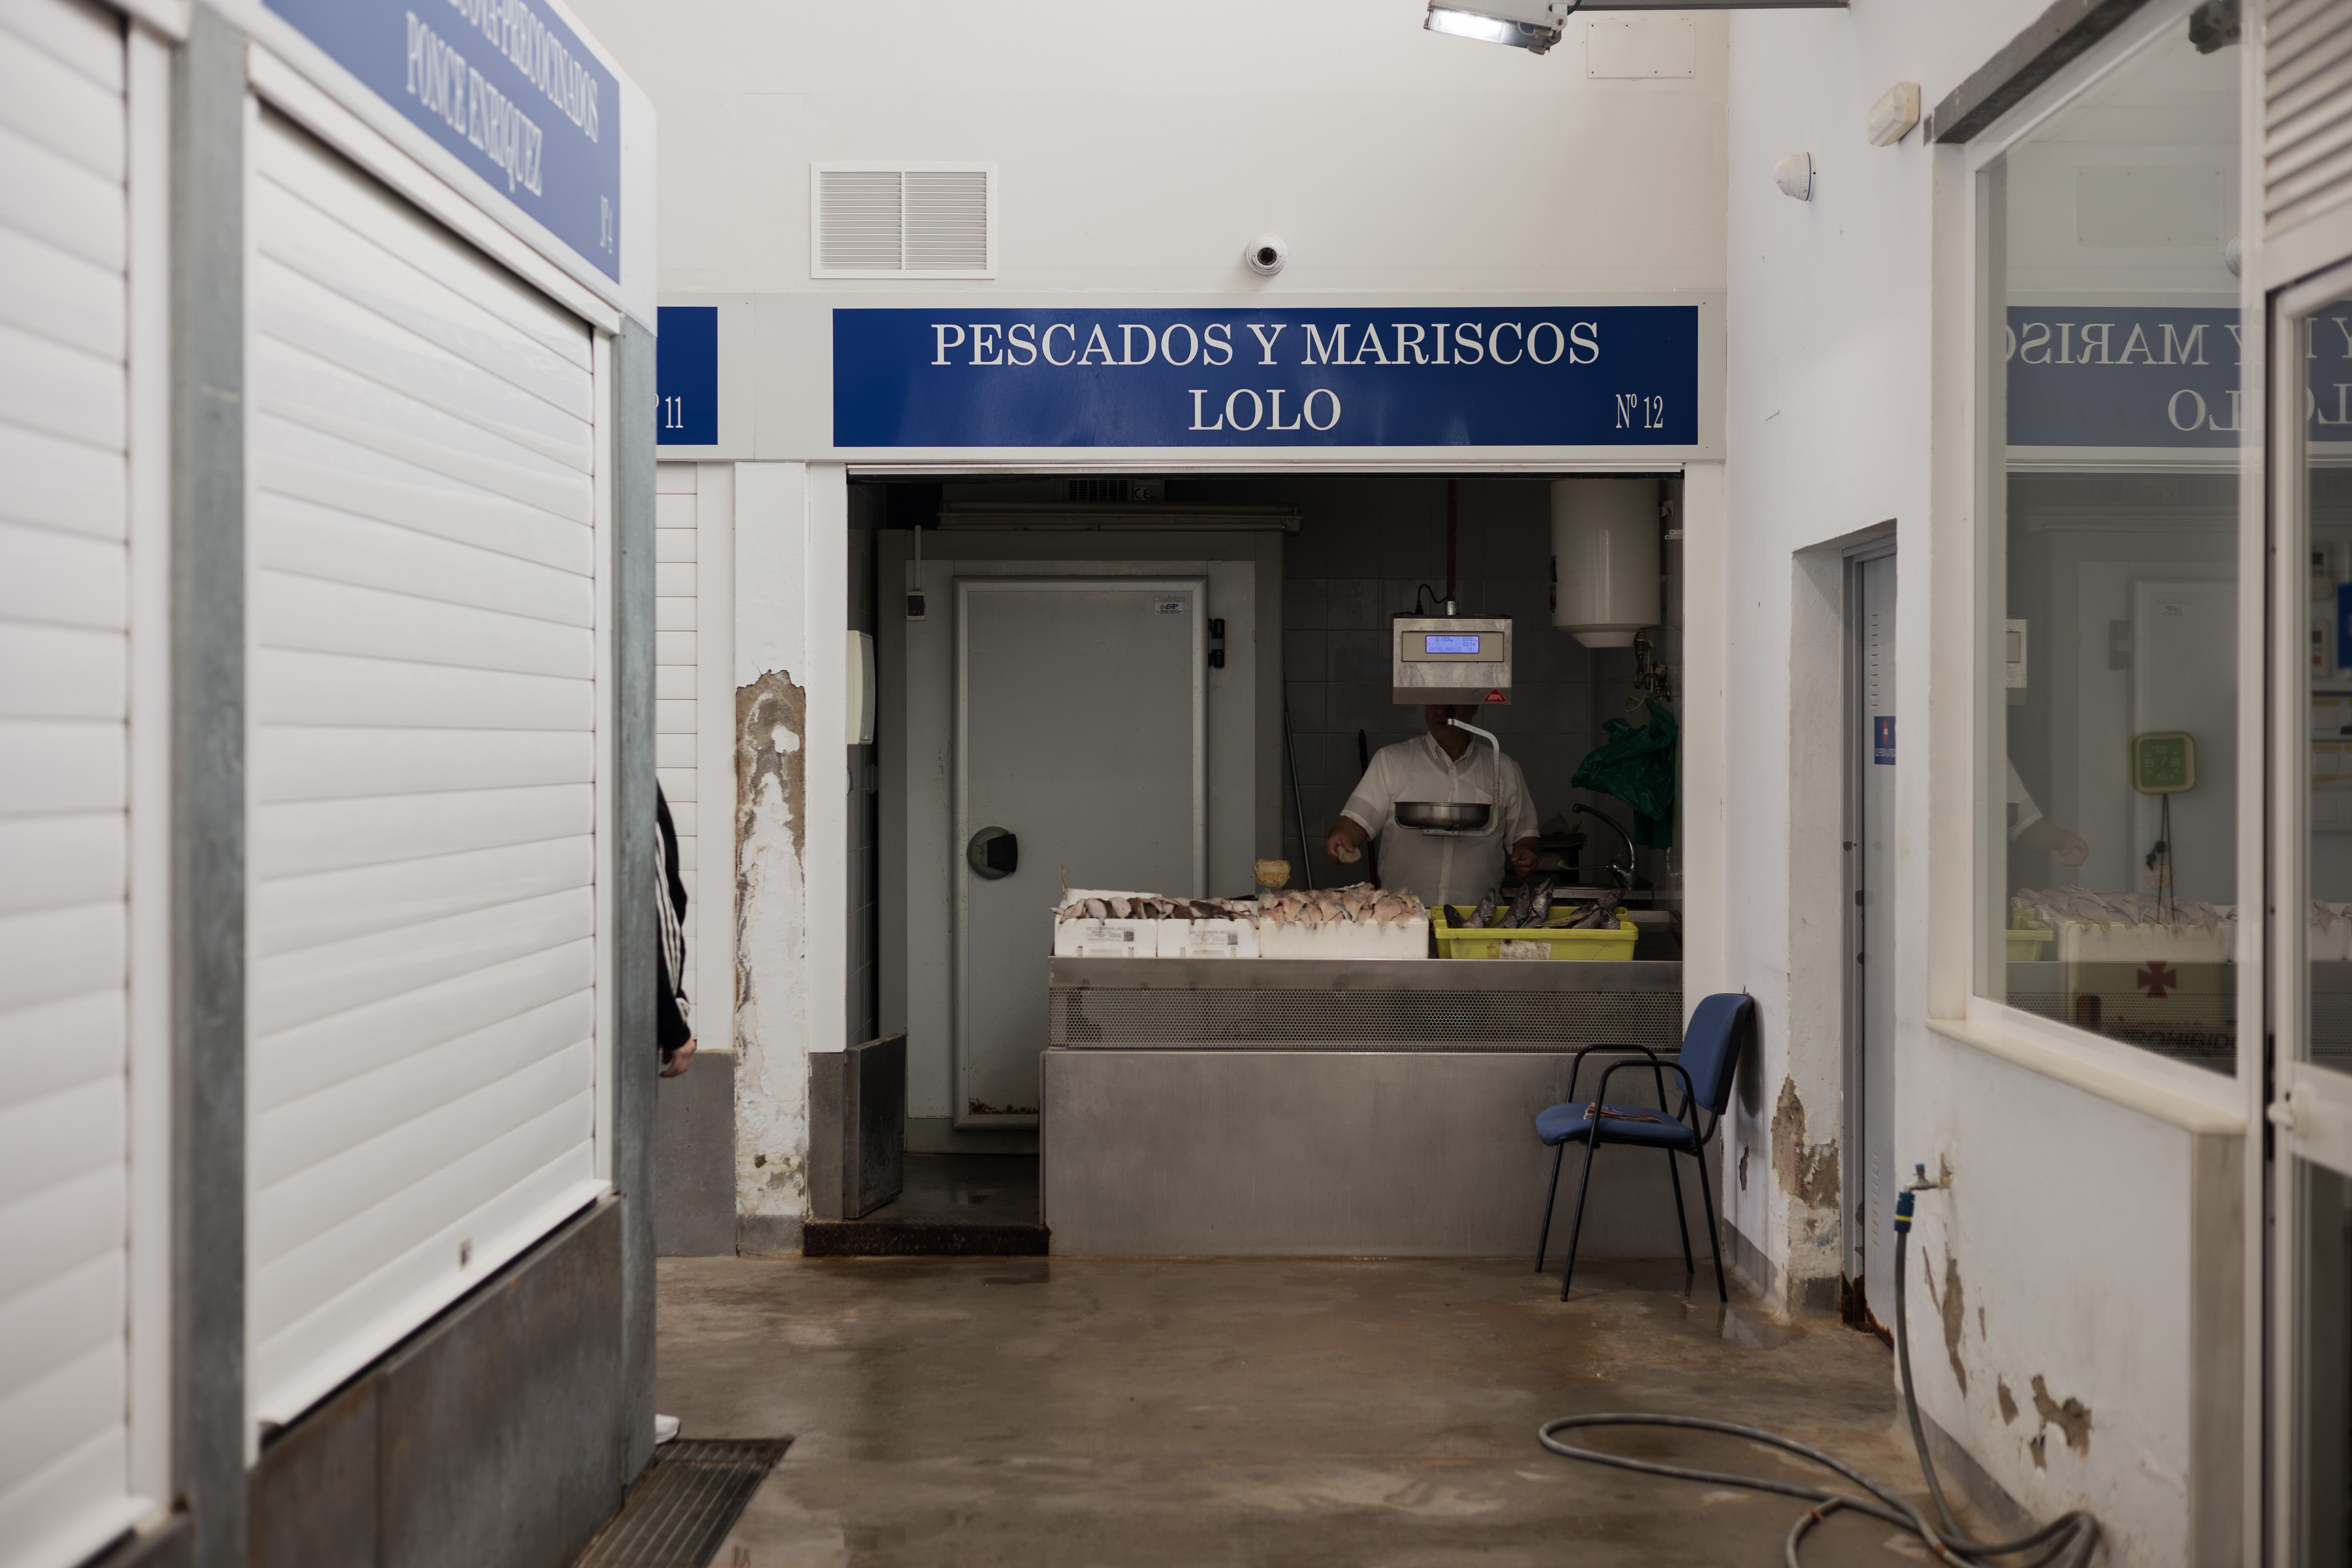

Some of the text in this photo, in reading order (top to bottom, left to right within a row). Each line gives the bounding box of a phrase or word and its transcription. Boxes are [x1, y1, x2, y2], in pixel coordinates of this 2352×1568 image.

[406, 10, 542, 197] PONCE ENRIQUEZ
[931, 322, 1599, 365] PESCADOS Y MARISCOS
[665, 396, 683, 428] 11
[1188, 389, 1341, 431] LOLO
[1616, 393, 1663, 428] Nº 12
